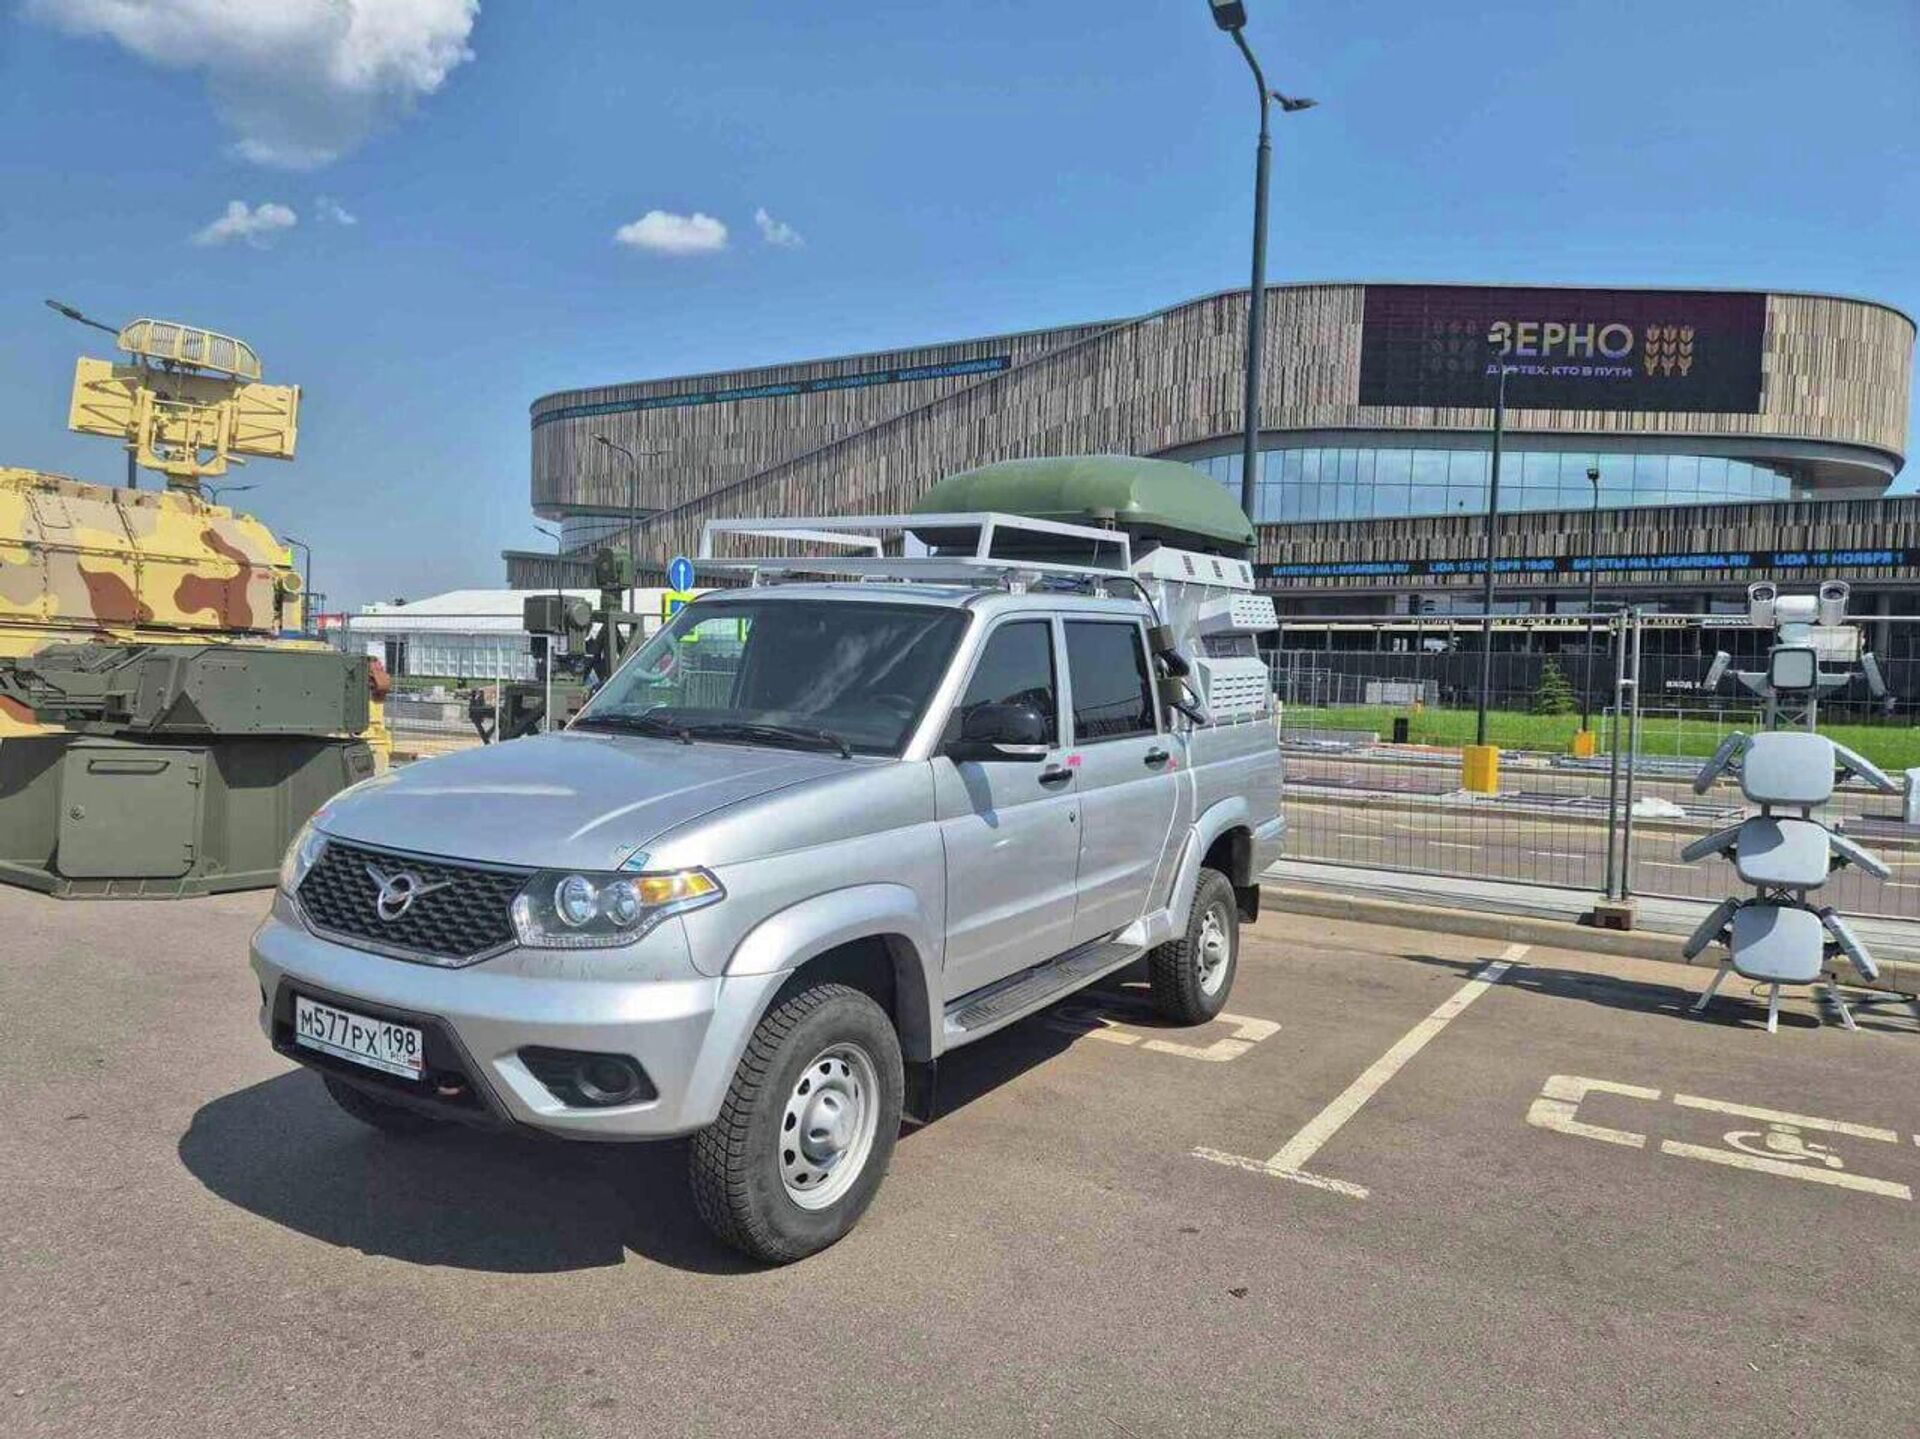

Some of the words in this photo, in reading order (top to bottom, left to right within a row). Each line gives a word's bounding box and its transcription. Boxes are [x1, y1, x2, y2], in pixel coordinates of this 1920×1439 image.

[1487, 321, 1634, 358] ЗЕРНО
[1552, 366, 1579, 376] КТО
[1582, 366, 1592, 376] В
[1594, 366, 1633, 377] ПУТИ
[1628, 558, 1647, 569] НА
[1651, 555, 1749, 568] LIVEARENA.RU
[1774, 553, 1807, 565] LIDA
[1831, 551, 1892, 564] НОЯБРЯ
[383, 1026, 416, 1055] 198
